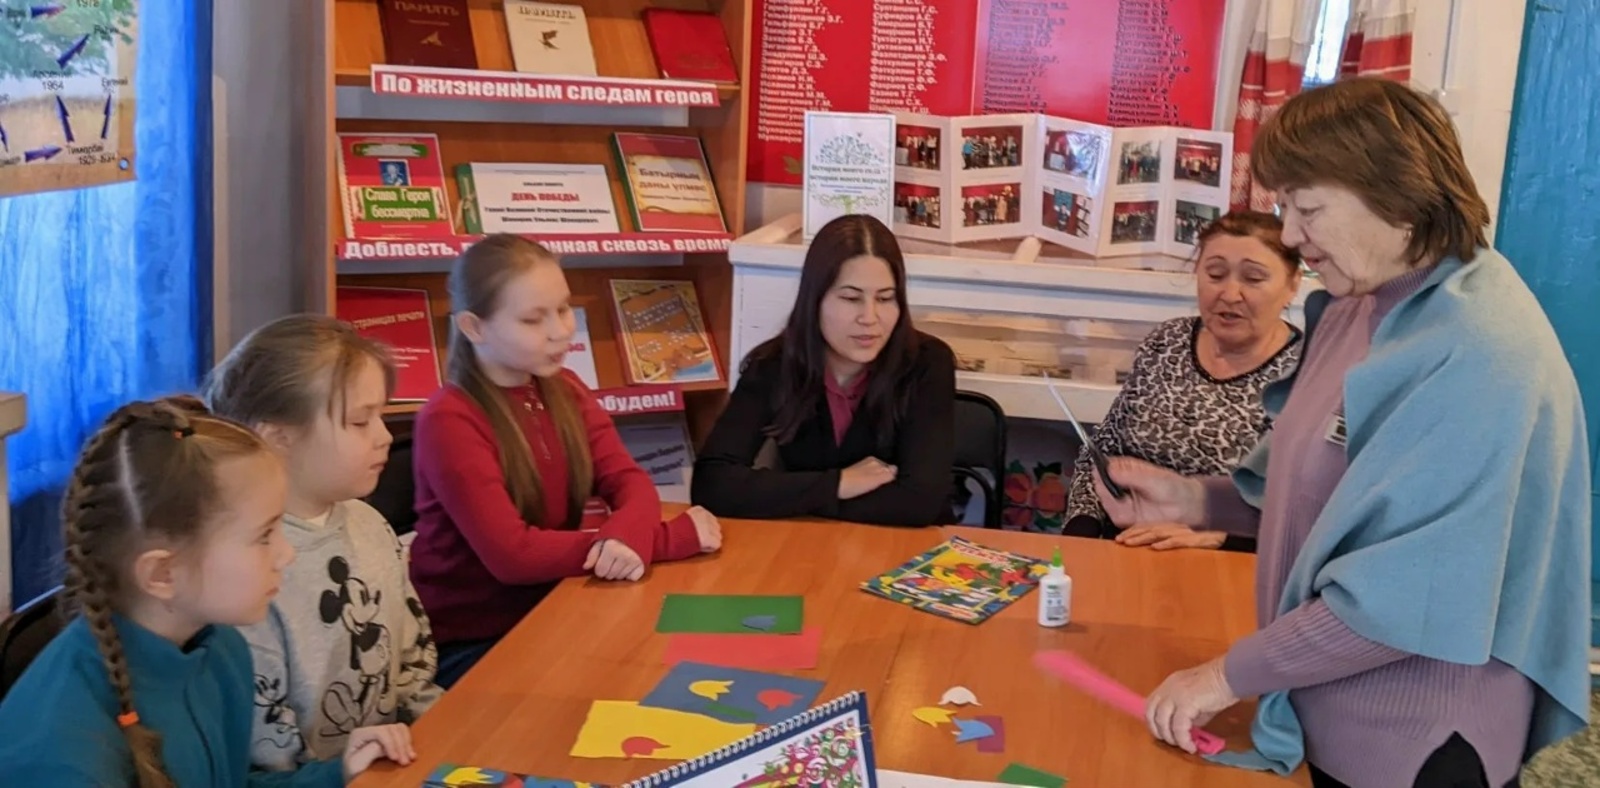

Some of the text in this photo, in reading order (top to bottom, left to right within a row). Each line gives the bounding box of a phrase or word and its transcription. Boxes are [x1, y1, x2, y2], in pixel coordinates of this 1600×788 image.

[518, 5, 577, 19] ПАМЯТЬ
[381, 74, 714, 106] По жизненным следам героя
[365, 188, 398, 202] Слава
[511, 192, 580, 203] ДЕНЬ ПОБЕДЫ
[370, 204, 431, 222] бессмертна
[345, 241, 459, 261] Доблесть,
[602, 239, 671, 253] сквозь
[603, 390, 676, 412] будем!
